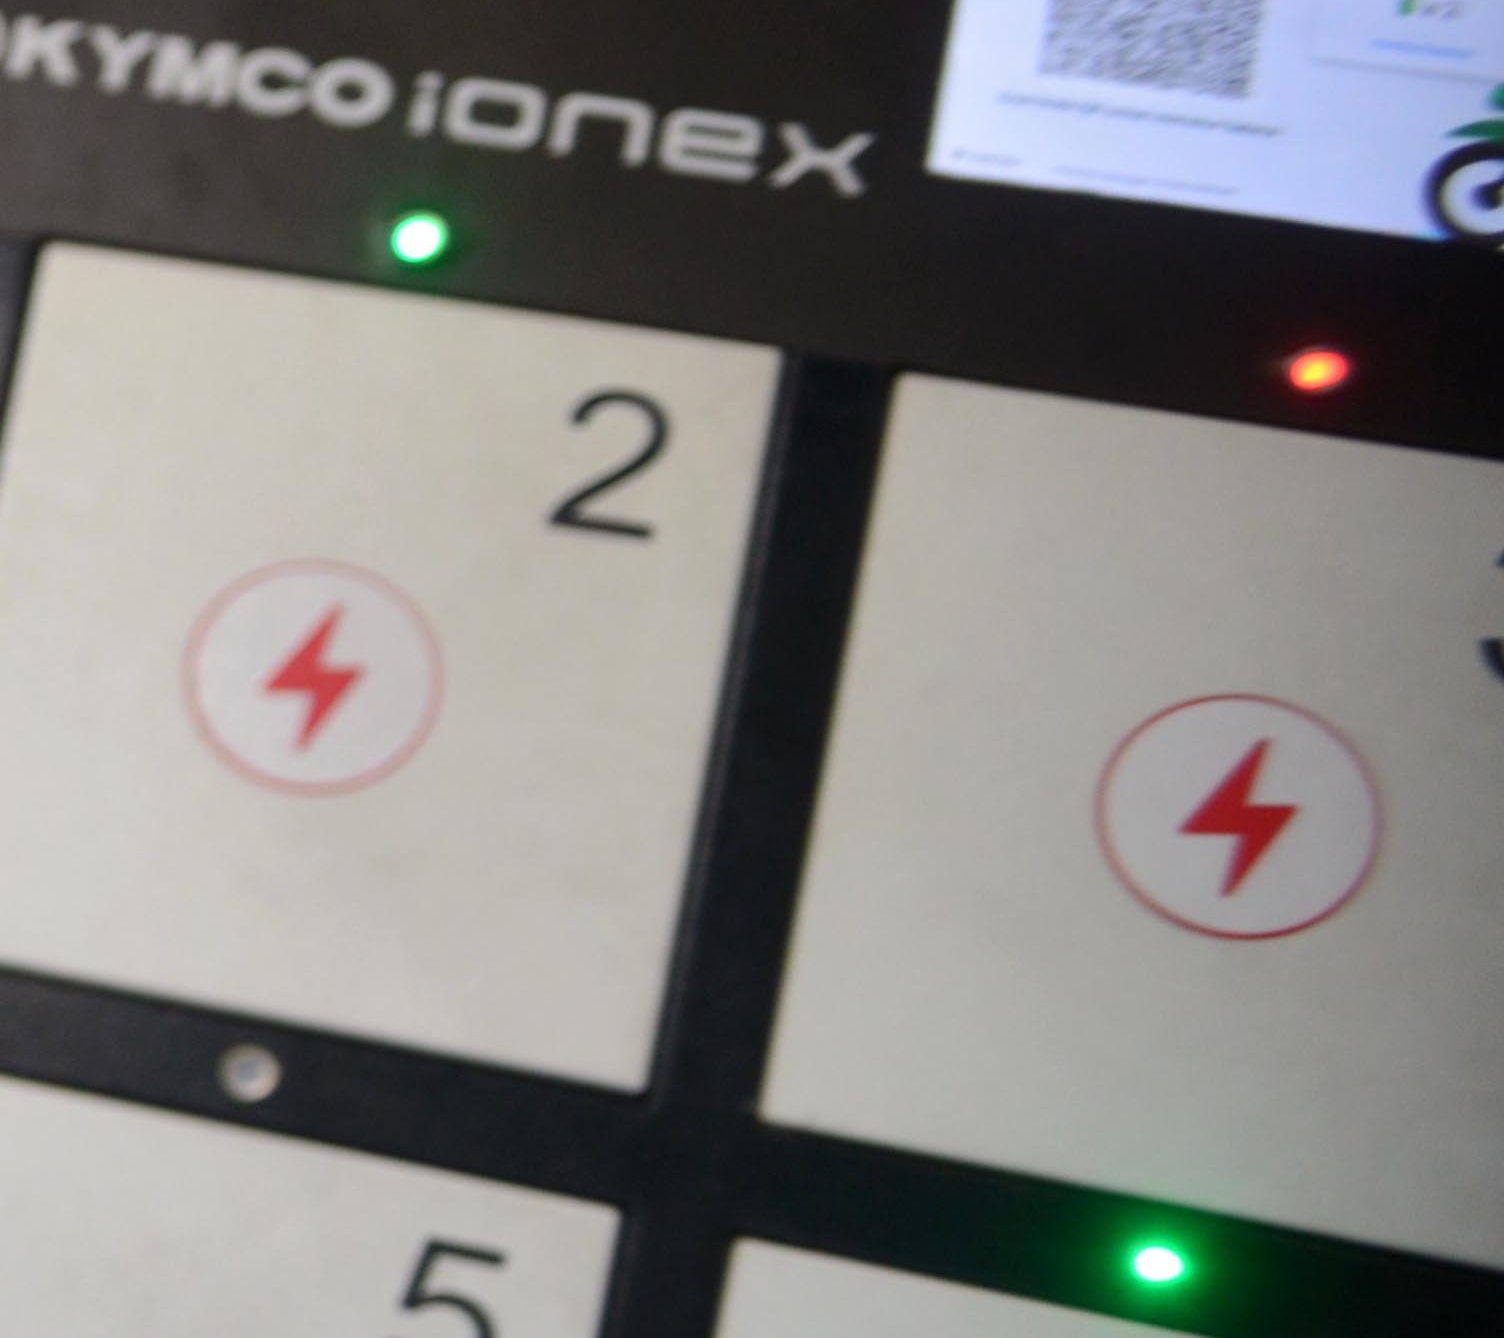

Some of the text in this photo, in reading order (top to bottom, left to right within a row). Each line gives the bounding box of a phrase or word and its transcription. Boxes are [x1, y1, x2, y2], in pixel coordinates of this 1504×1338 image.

[3, 13, 396, 128] KYMCO
[407, 71, 876, 197] ionex
[544, 388, 672, 542] 2
